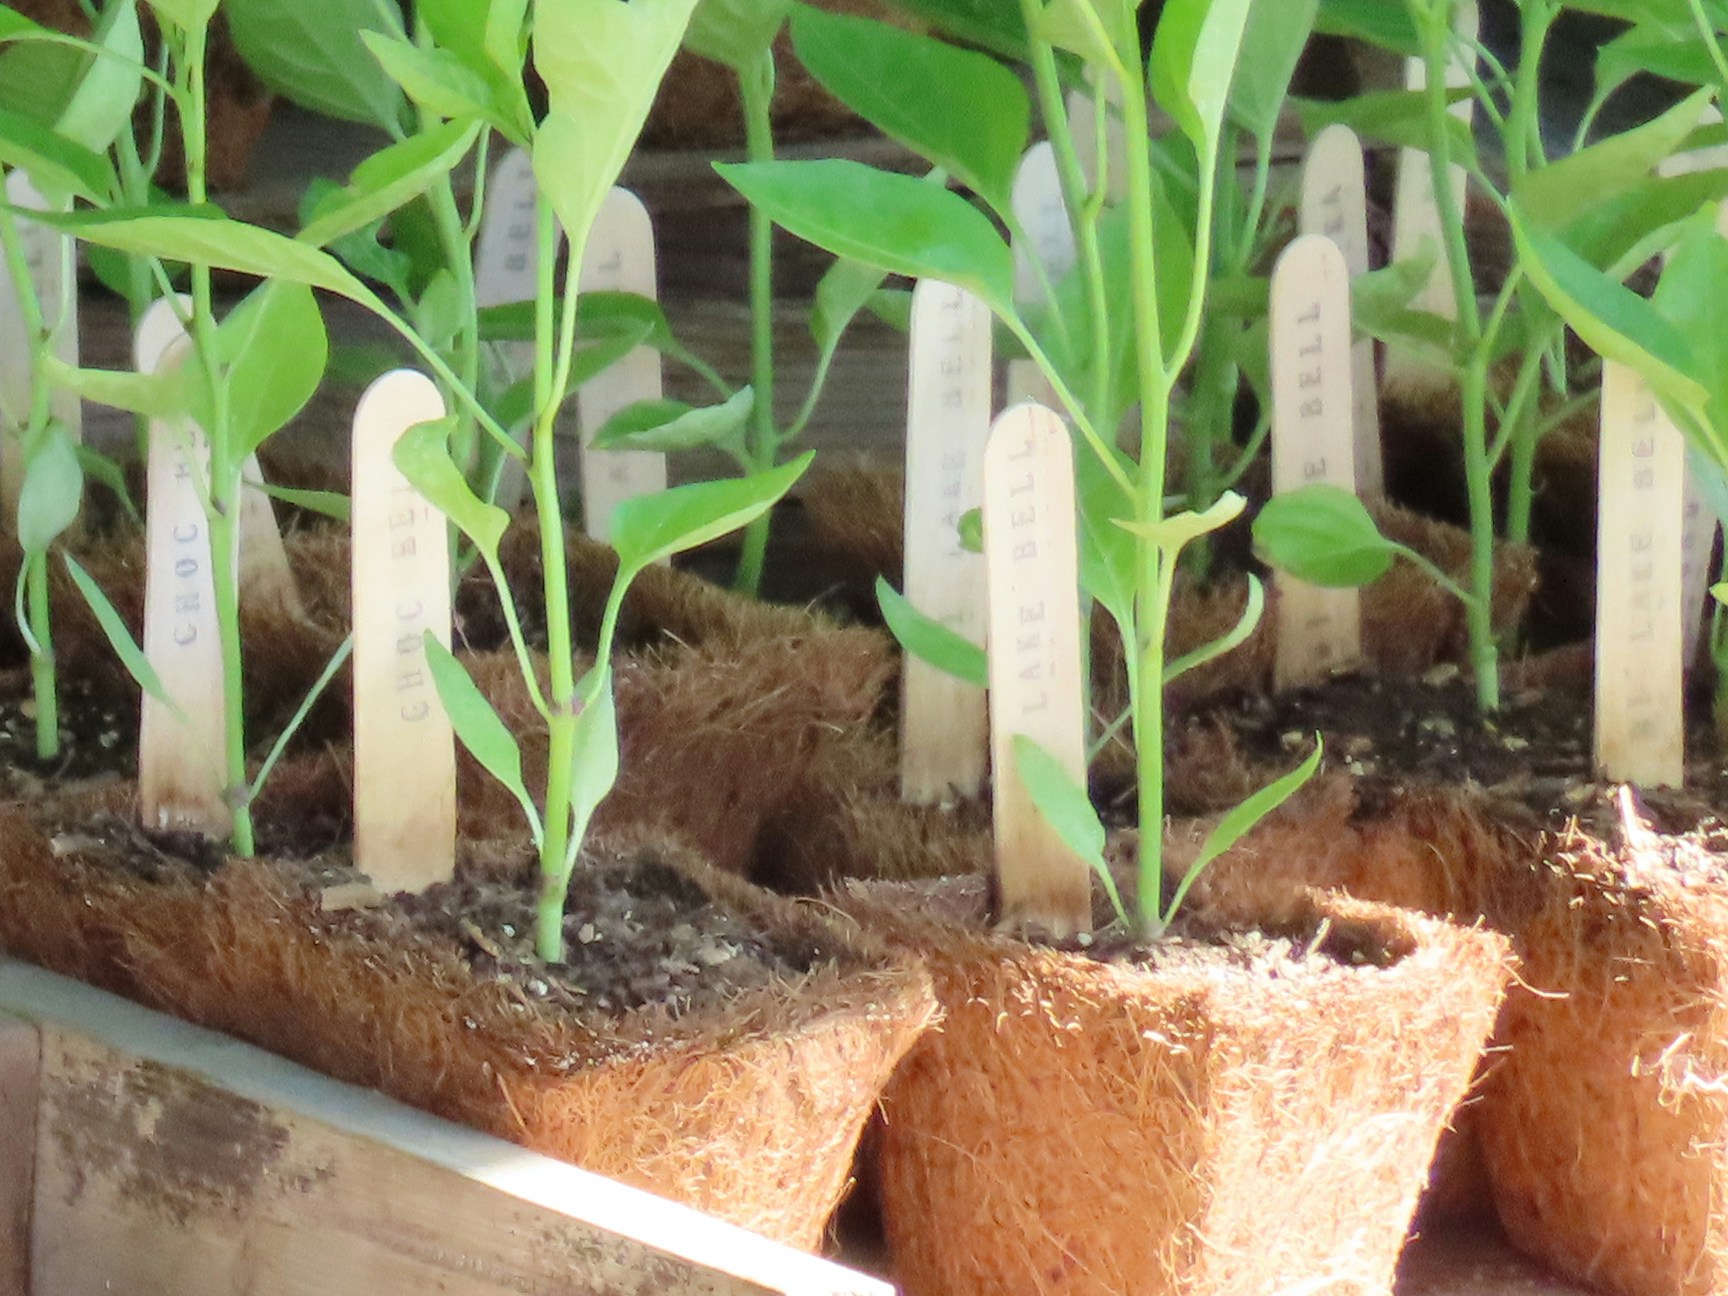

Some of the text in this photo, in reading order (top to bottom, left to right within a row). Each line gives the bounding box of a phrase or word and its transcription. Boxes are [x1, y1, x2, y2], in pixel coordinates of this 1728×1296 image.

[1297, 301, 1323, 417] BELL
[1631, 376, 1655, 489] BEL
[172, 522, 201, 645] CHOC
[1008, 439, 1048, 714] LAKE BELL
[1629, 534, 1655, 641] LAKE
[394, 600, 429, 722] CHOC
